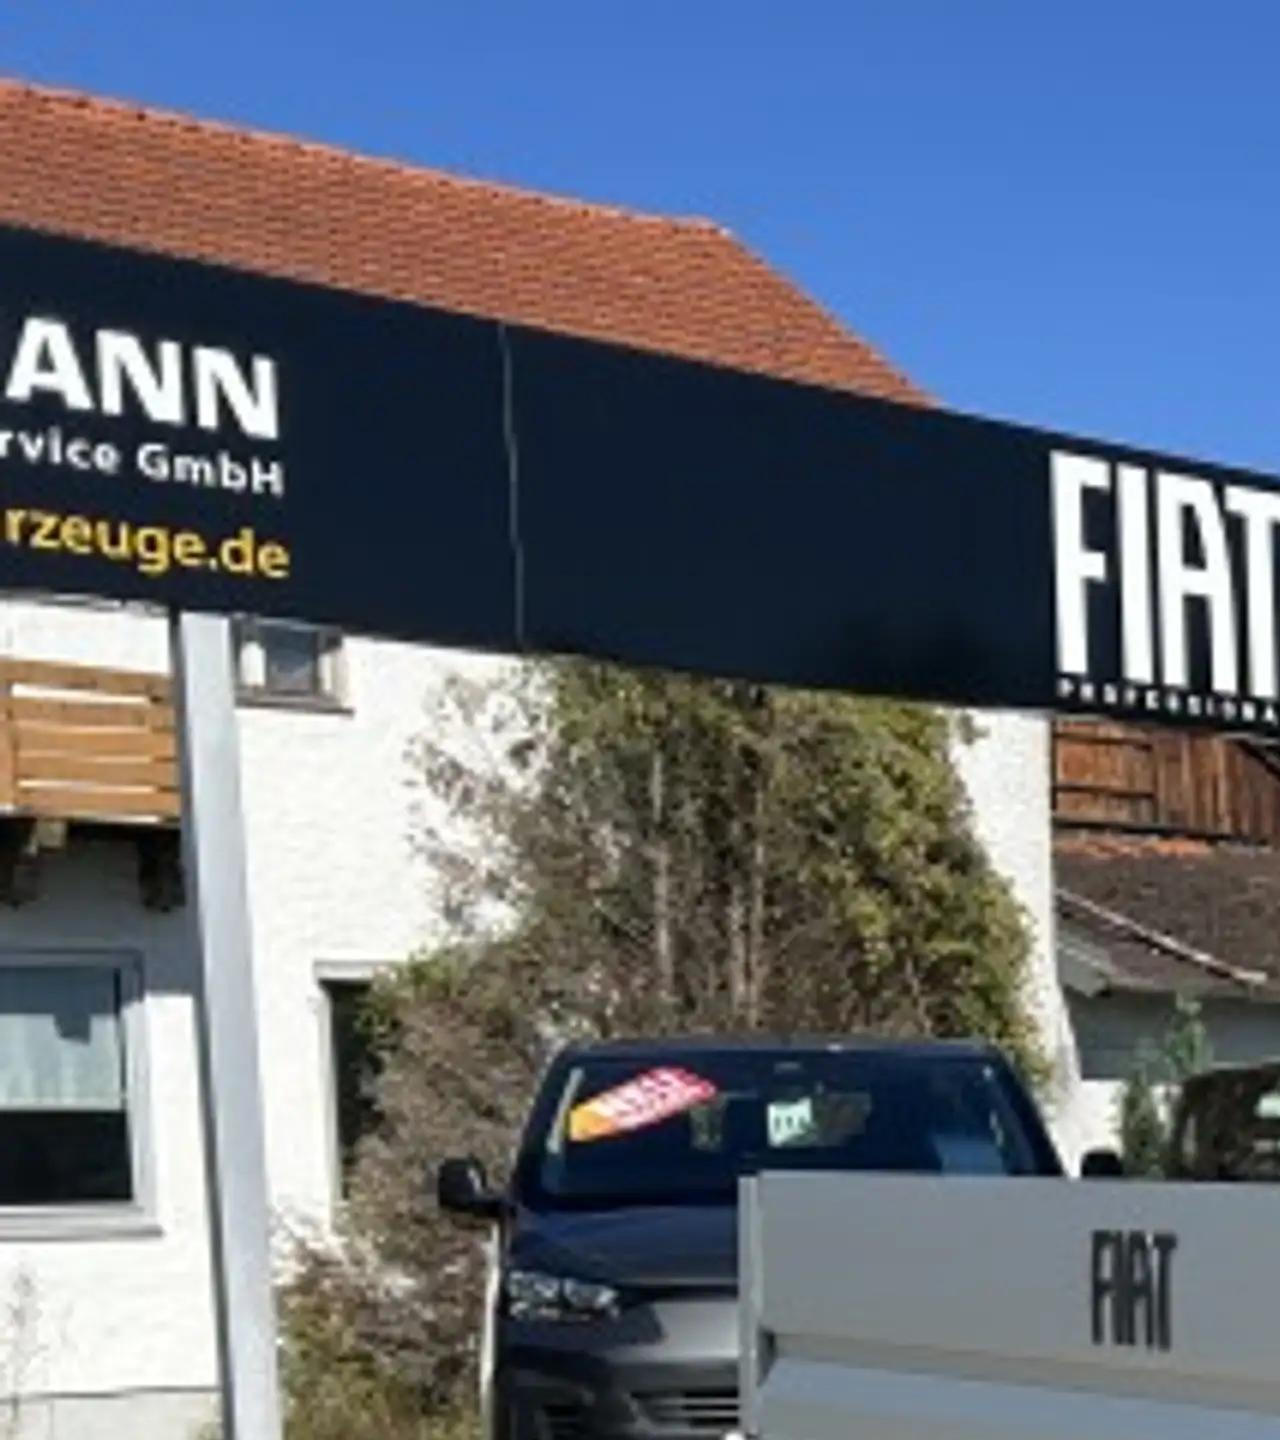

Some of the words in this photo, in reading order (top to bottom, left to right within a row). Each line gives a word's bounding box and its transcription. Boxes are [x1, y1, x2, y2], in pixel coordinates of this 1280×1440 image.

[4, 317, 279, 440] ANN
[136, 442, 285, 498] GmbH
[4, 507, 291, 579] rzeuge.de
[1091, 1229, 1178, 1351] FIAT
